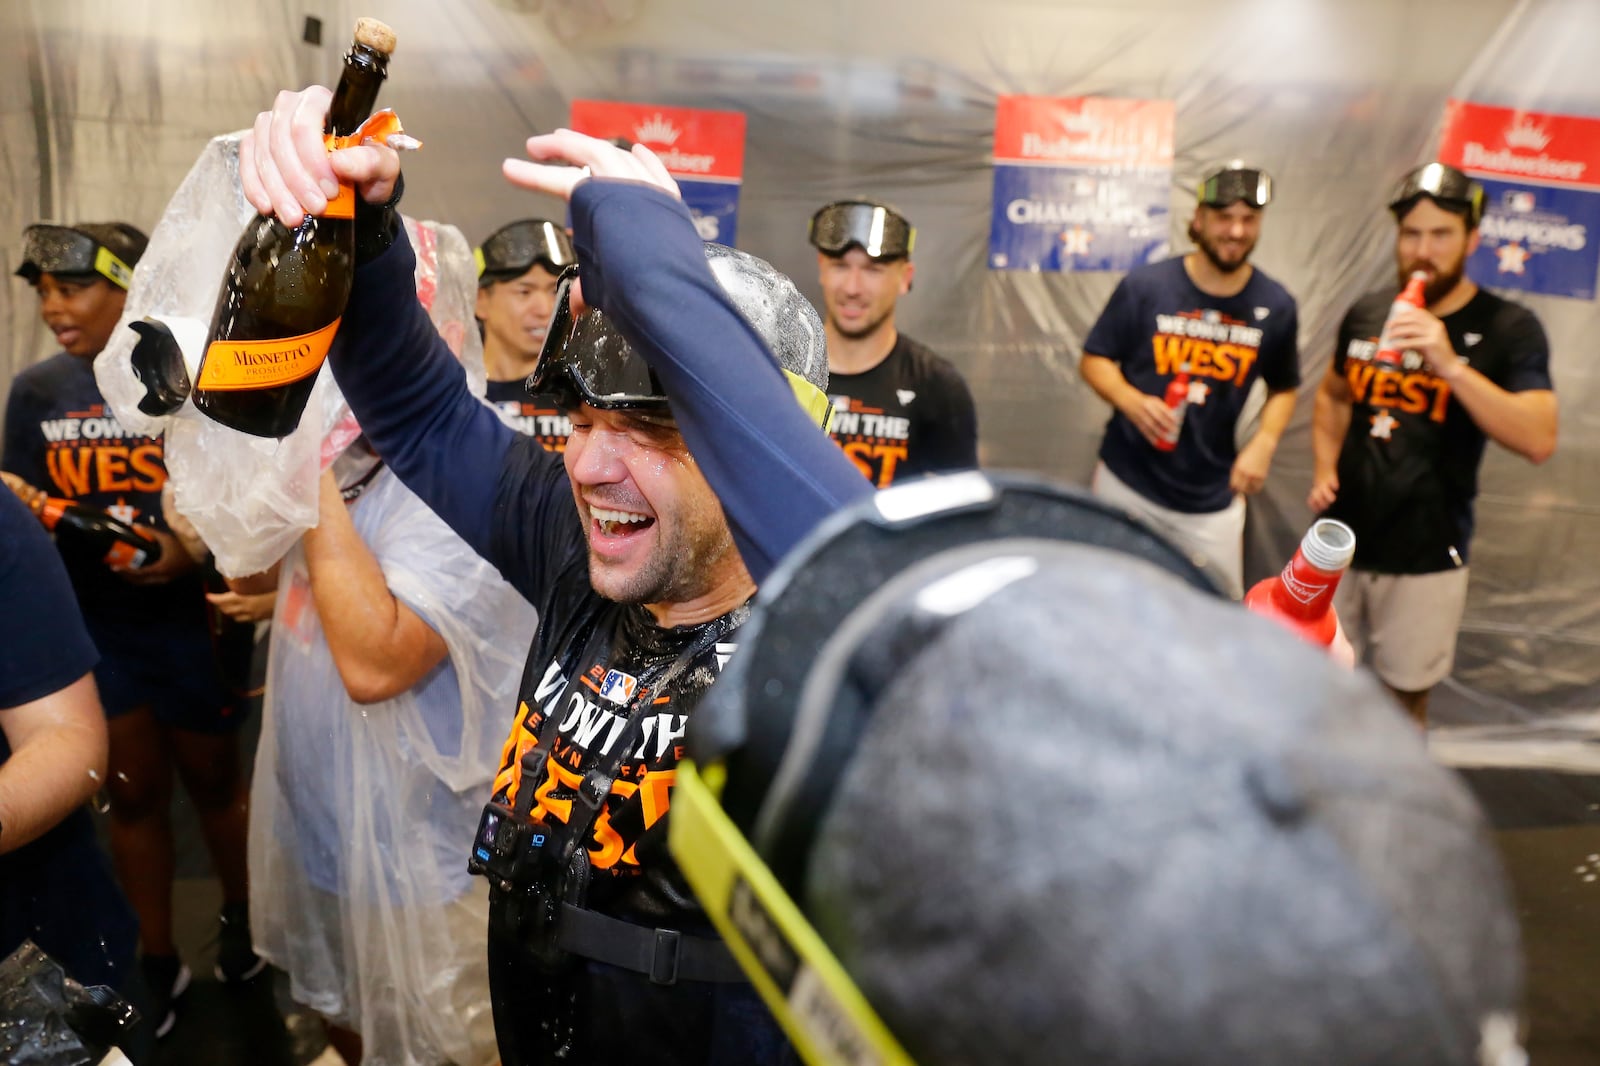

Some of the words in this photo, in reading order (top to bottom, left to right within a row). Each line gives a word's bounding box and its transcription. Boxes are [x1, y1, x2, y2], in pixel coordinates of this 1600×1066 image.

[1152, 335, 1258, 387] WEST
[40, 418, 80, 442] WE
[861, 413, 910, 439] THE
[46, 445, 169, 498] WES
